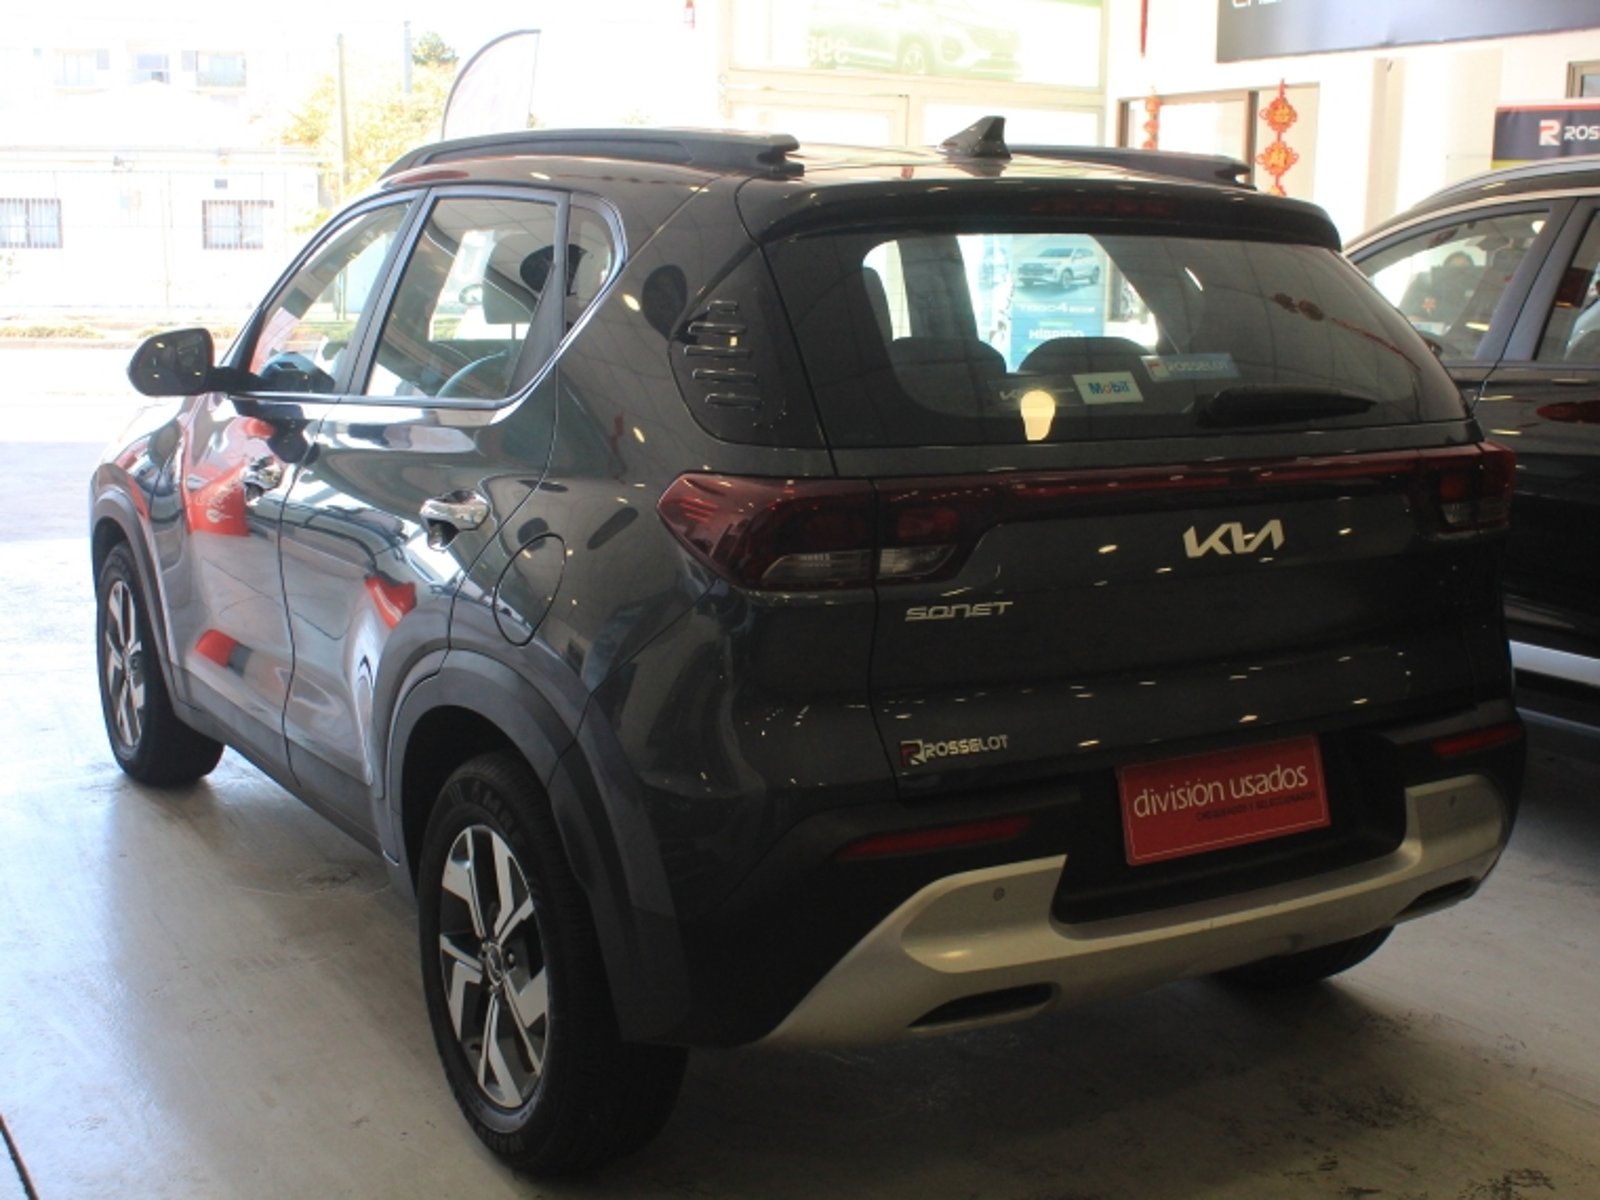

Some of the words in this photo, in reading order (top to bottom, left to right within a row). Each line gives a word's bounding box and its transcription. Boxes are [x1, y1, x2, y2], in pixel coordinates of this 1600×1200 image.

[1088, 380, 1131, 395] Mobil
[1182, 518, 1285, 559] KIA
[904, 601, 1014, 622] SONET
[924, 734, 1009, 759] ROSSELOT
[1133, 778, 1225, 818] división
[1230, 763, 1309, 800] usados
